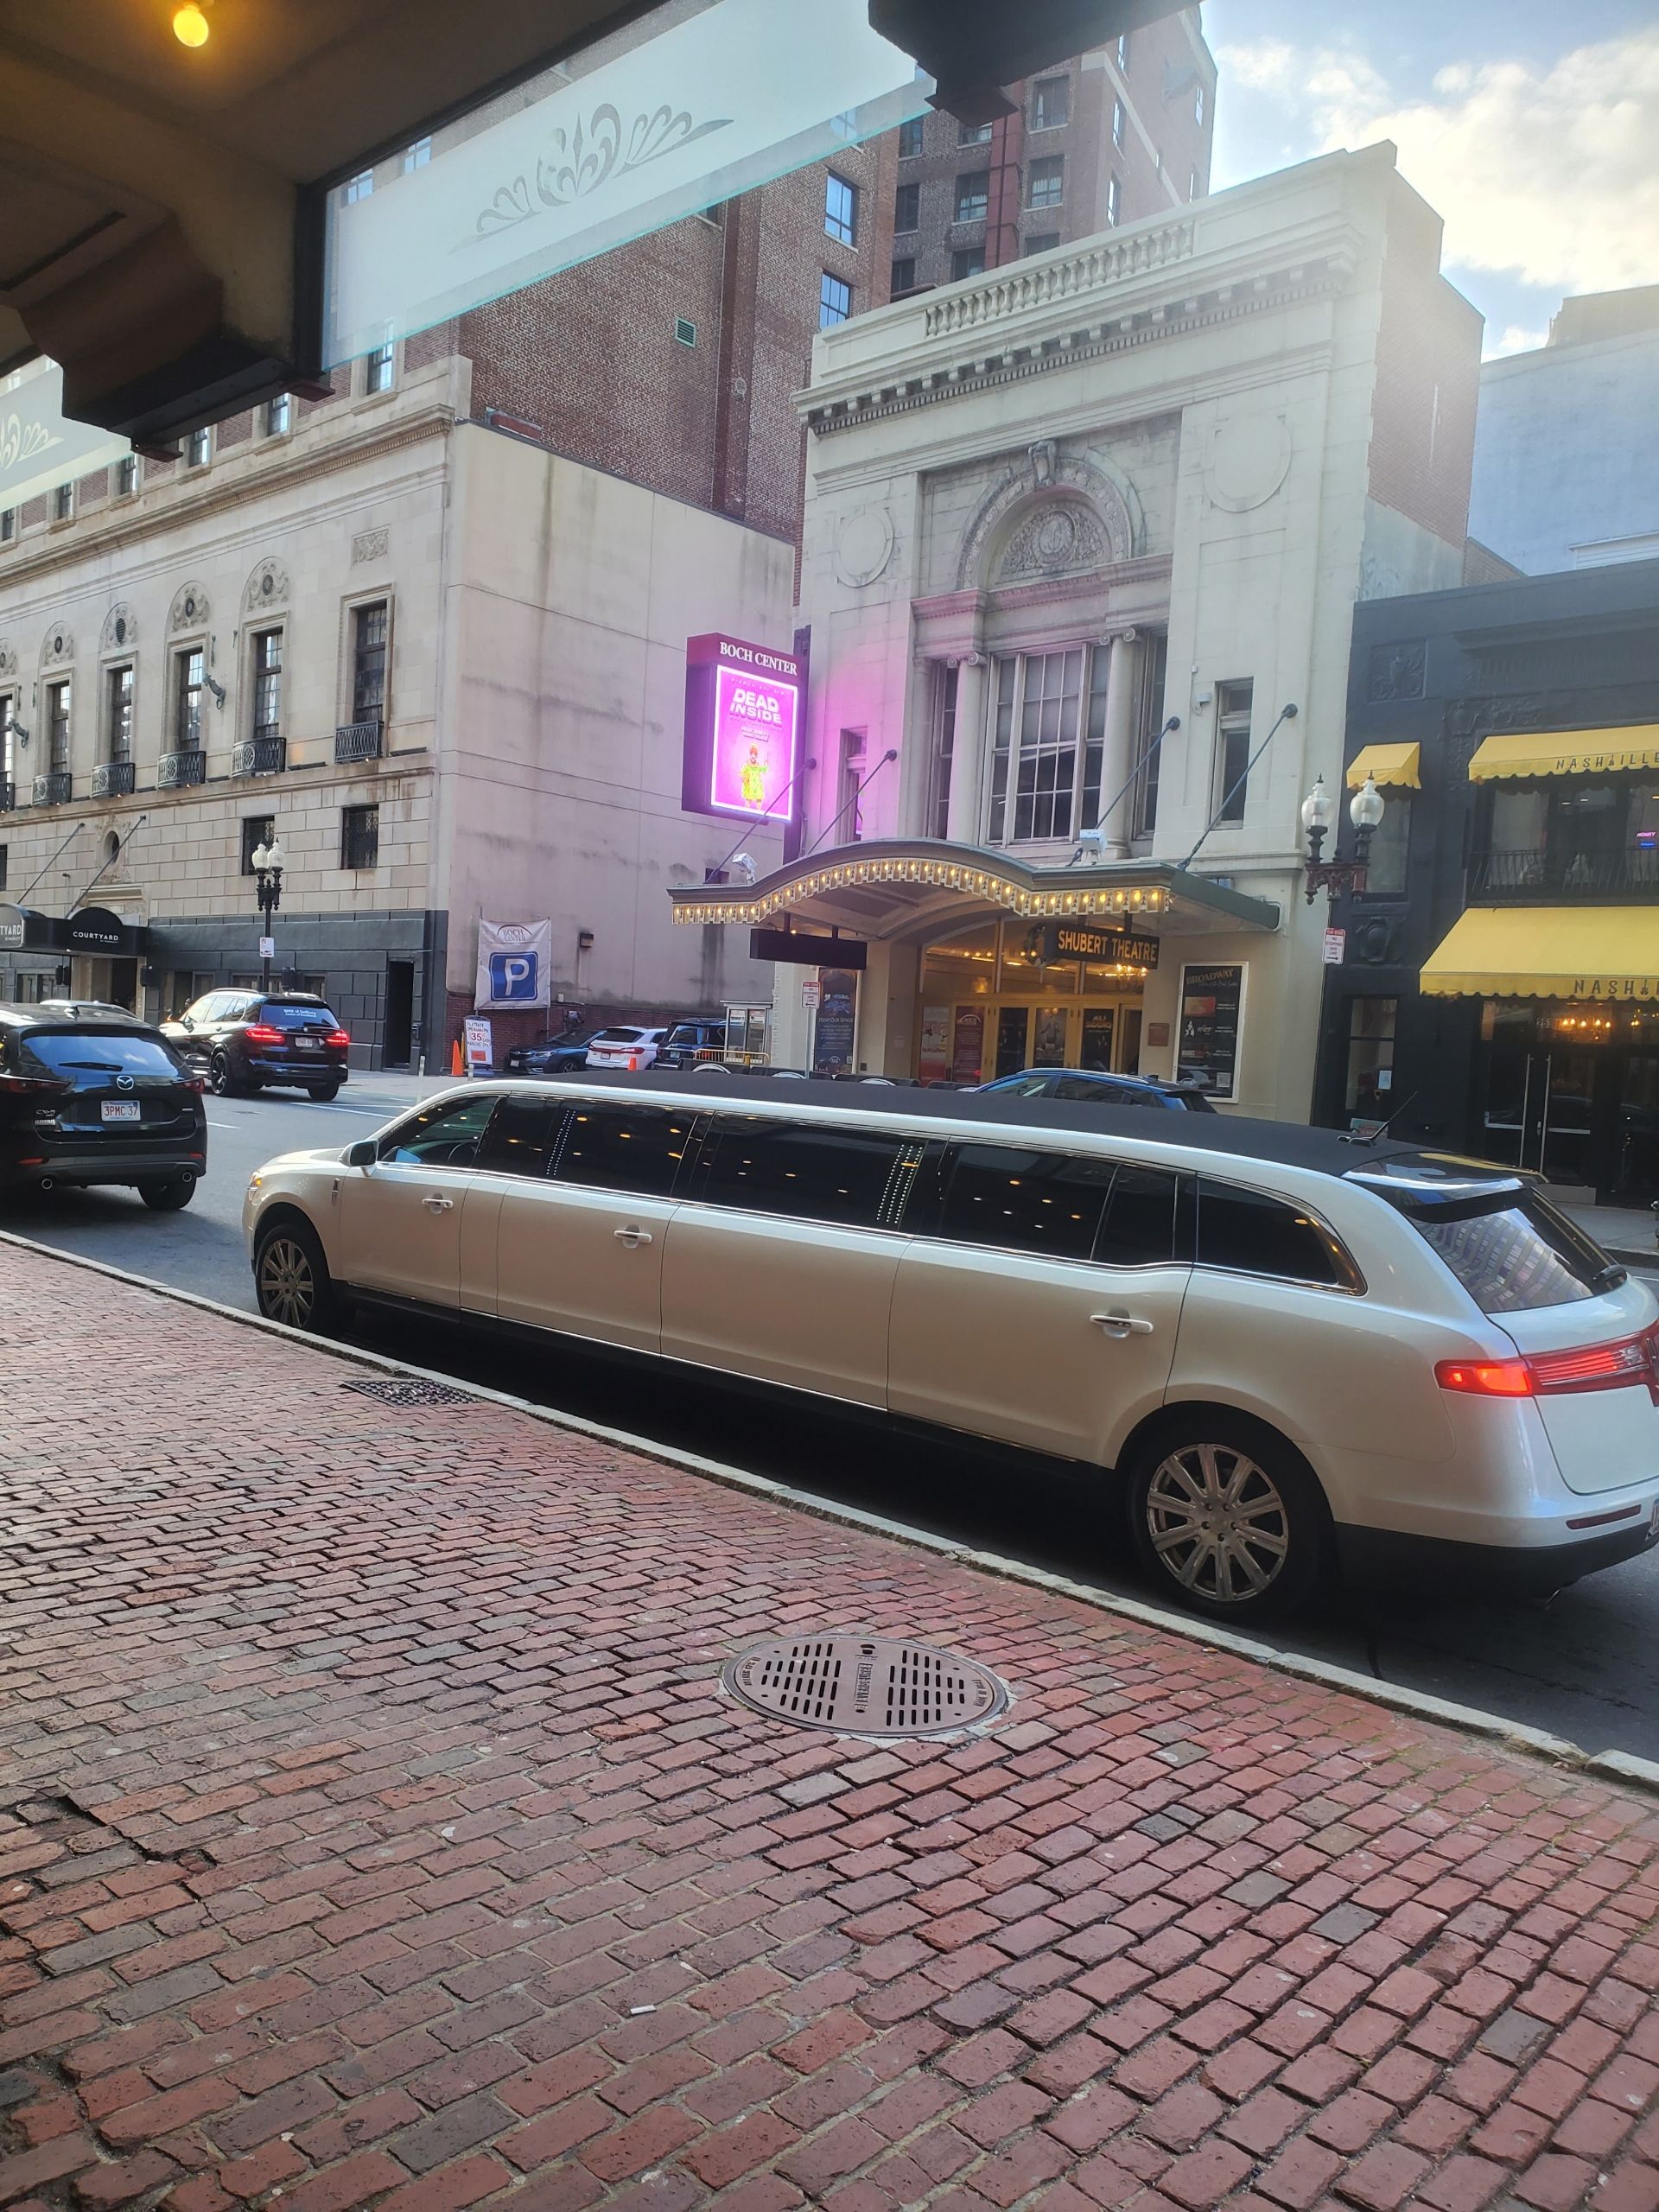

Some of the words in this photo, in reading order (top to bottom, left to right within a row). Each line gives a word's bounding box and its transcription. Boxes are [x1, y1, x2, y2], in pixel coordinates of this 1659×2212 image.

[720, 642, 753, 663] BOCH
[755, 652, 797, 676] CENTER
[733, 688, 779, 714] DEAD
[729, 702, 782, 726] INSIDE
[73, 931, 118, 941] COURTYARD
[1058, 930, 1108, 955] SHUBERT
[1112, 938, 1157, 962] THEATRE
[505, 958, 529, 995] P
[1186, 968, 1234, 985] BROADWAY
[471, 1033, 482, 1041] 35
[104, 1106, 125, 1116] 3PMC
[128, 1106, 138, 1116] 37
